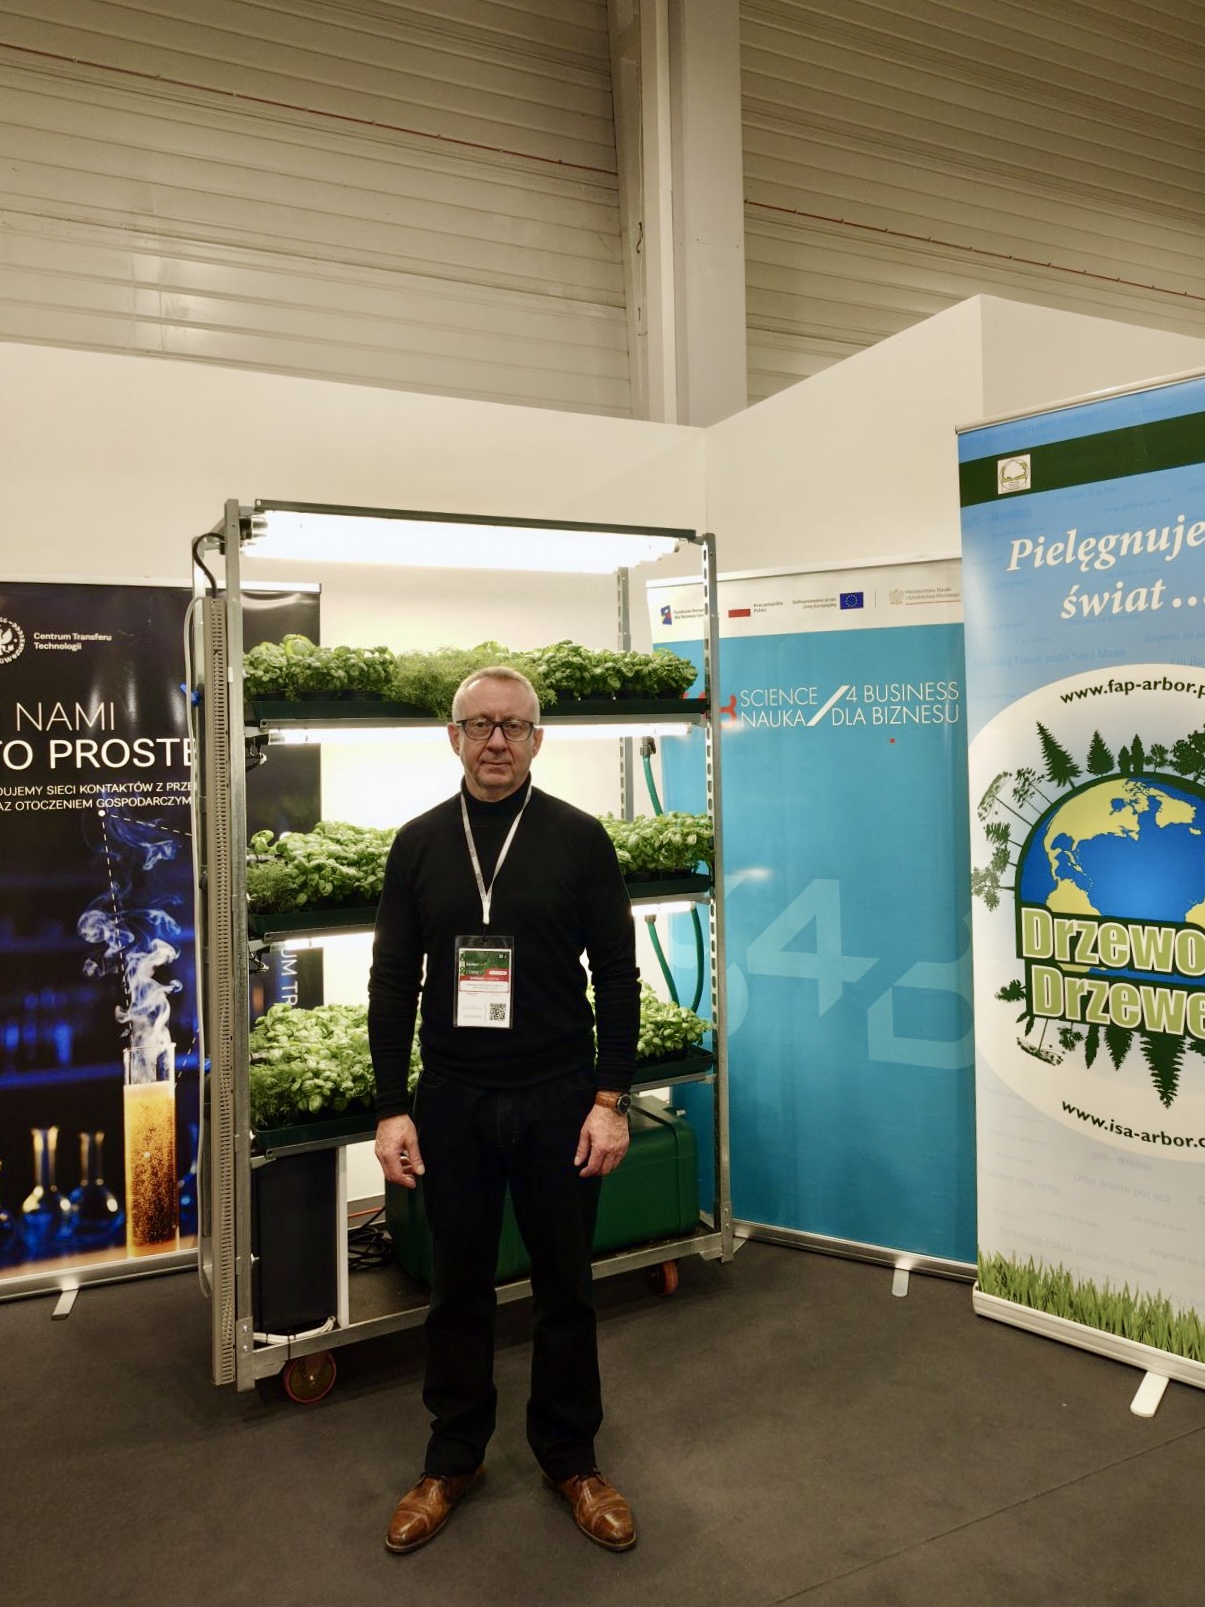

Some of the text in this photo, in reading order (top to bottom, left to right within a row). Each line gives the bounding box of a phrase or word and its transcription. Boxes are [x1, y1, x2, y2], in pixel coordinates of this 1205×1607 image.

[1006, 514, 1205, 573] Pielęgnuje
[33, 632, 112, 642] Centrum Transferu
[33, 642, 82, 652] Technologii
[740, 687, 818, 708] SCIENCE
[846, 685, 858, 703] 4
[864, 681, 960, 703] BUSINESS
[16, 702, 116, 732] NAMI
[740, 703, 960, 728] NAUKA DLA BIZNESU
[0, 739, 34, 771] O
[46, 784, 76, 796] SIECI
[79, 780, 153, 794] KONTAKTÓW
[155, 782, 164, 792] Z
[15, 798, 93, 811] OTOCZENIEM
[96, 795, 192, 809] GOSPODARCZYM
[1021, 907, 1205, 977] Drzewo
